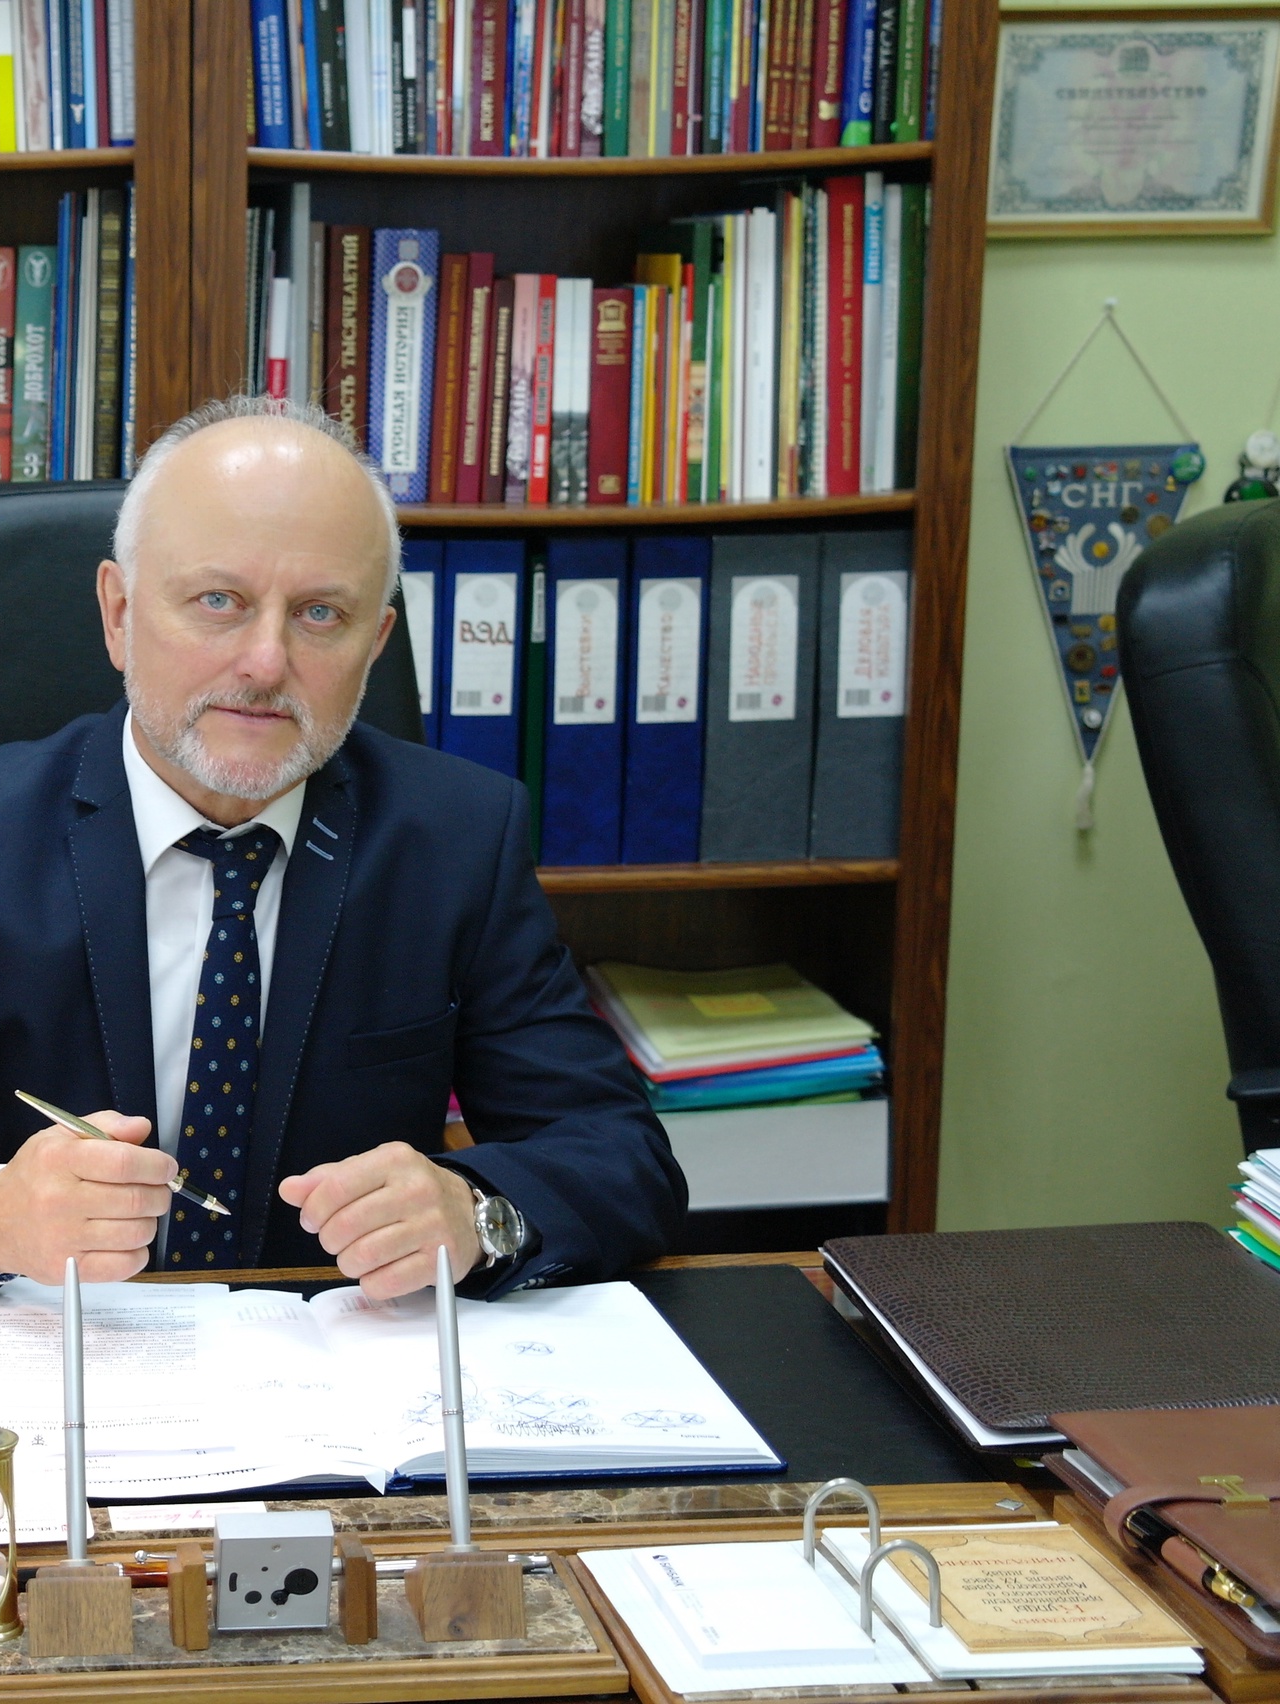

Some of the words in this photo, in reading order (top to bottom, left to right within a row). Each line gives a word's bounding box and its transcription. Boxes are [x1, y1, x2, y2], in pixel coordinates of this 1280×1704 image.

[341, 233, 360, 370] ТЫСЯЧЕЛЕТИЙ
[392, 305, 409, 384] ИСТОРИЯ
[23, 324, 45, 403] ДОБРОХОТ
[390, 390, 407, 467] РУССКАЯ
[23, 452, 39, 479] 3
[1061, 481, 1144, 509] СНГ
[460, 621, 514, 646] ВЭД
[1001, 1589, 1086, 1598] Чувашского
[1006, 1581, 1088, 1590] Марийского
[981, 1595, 1104, 1605] предприниматели
[1013, 1604, 1085, 1614] Купцы
